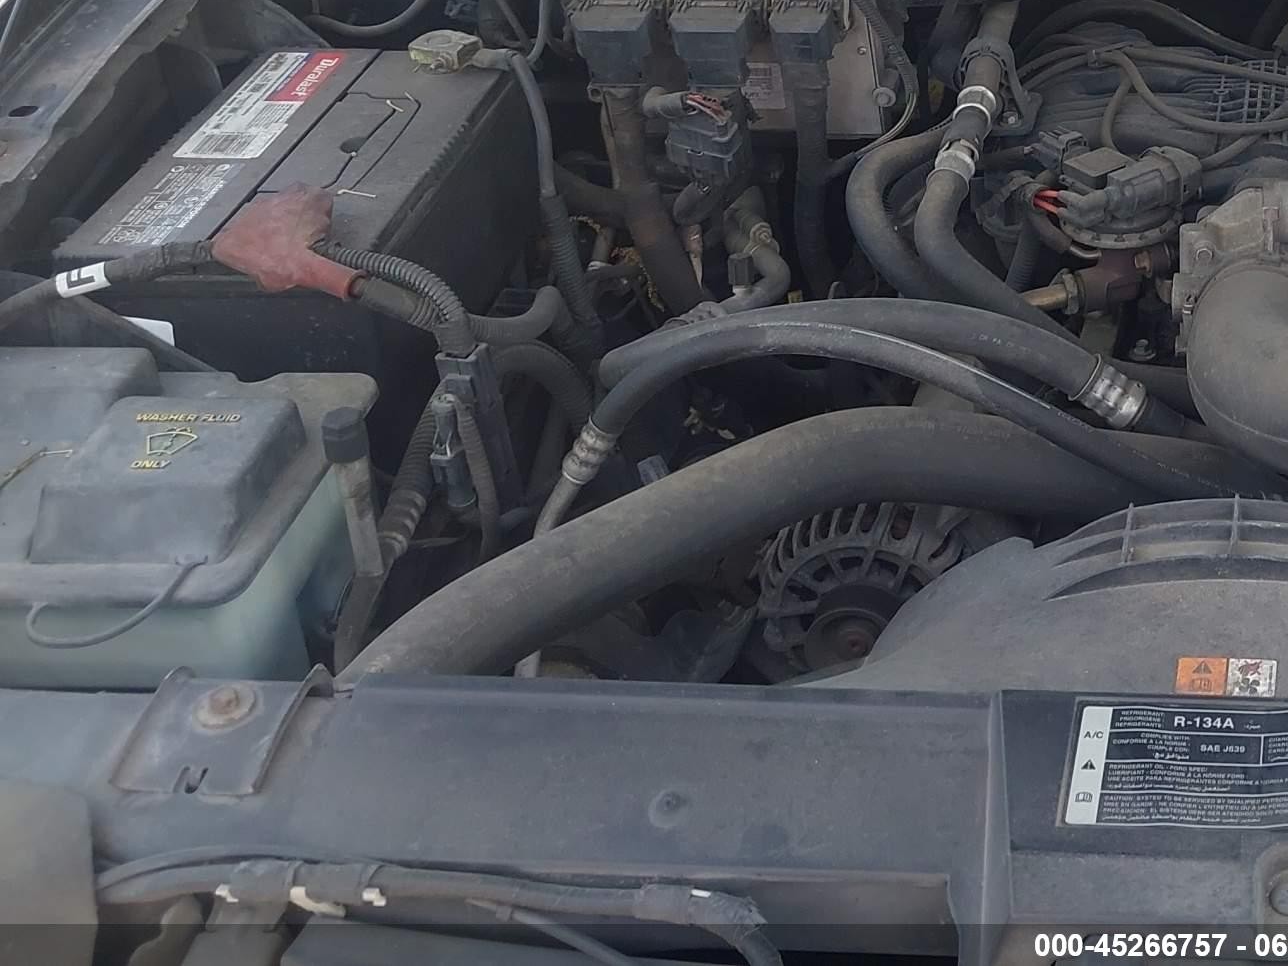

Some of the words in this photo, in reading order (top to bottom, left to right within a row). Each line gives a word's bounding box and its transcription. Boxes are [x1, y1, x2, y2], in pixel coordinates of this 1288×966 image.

[291, 57, 340, 98] Duralast
[136, 413, 198, 423] WASHER
[200, 413, 242, 423] FLUID
[129, 460, 171, 469] ONLY
[1173, 715, 1235, 730] R-134A
[1084, 730, 1104, 739] A/C
[1200, 744, 1221, 752] SAE
